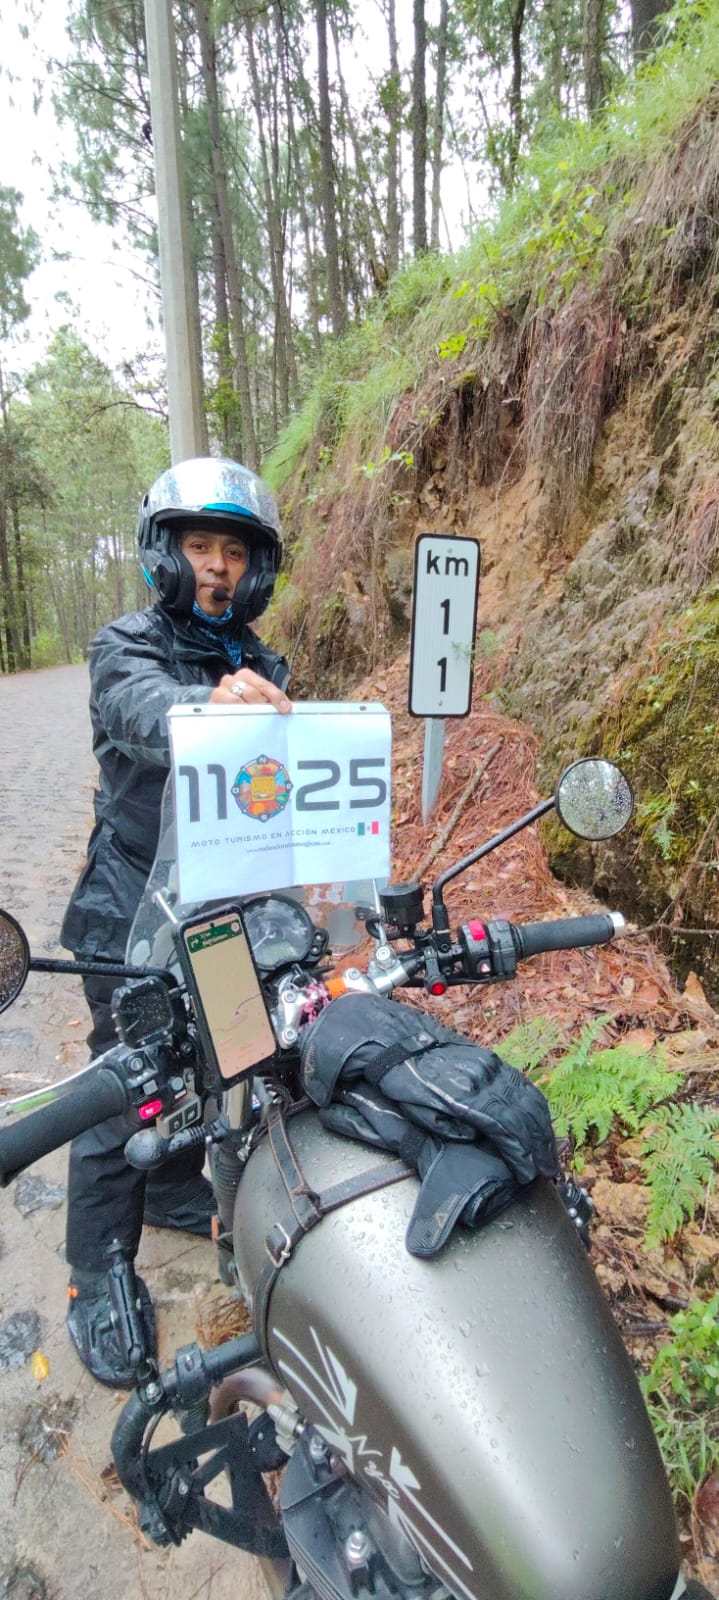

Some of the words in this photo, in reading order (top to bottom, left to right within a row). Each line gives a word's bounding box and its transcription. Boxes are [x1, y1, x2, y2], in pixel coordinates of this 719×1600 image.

[426, 550, 469, 576] km
[440, 598, 451, 635] 1
[437, 657, 447, 692] 1
[191, 838, 221, 848] MOTO
[224, 833, 267, 844] TURISMO
